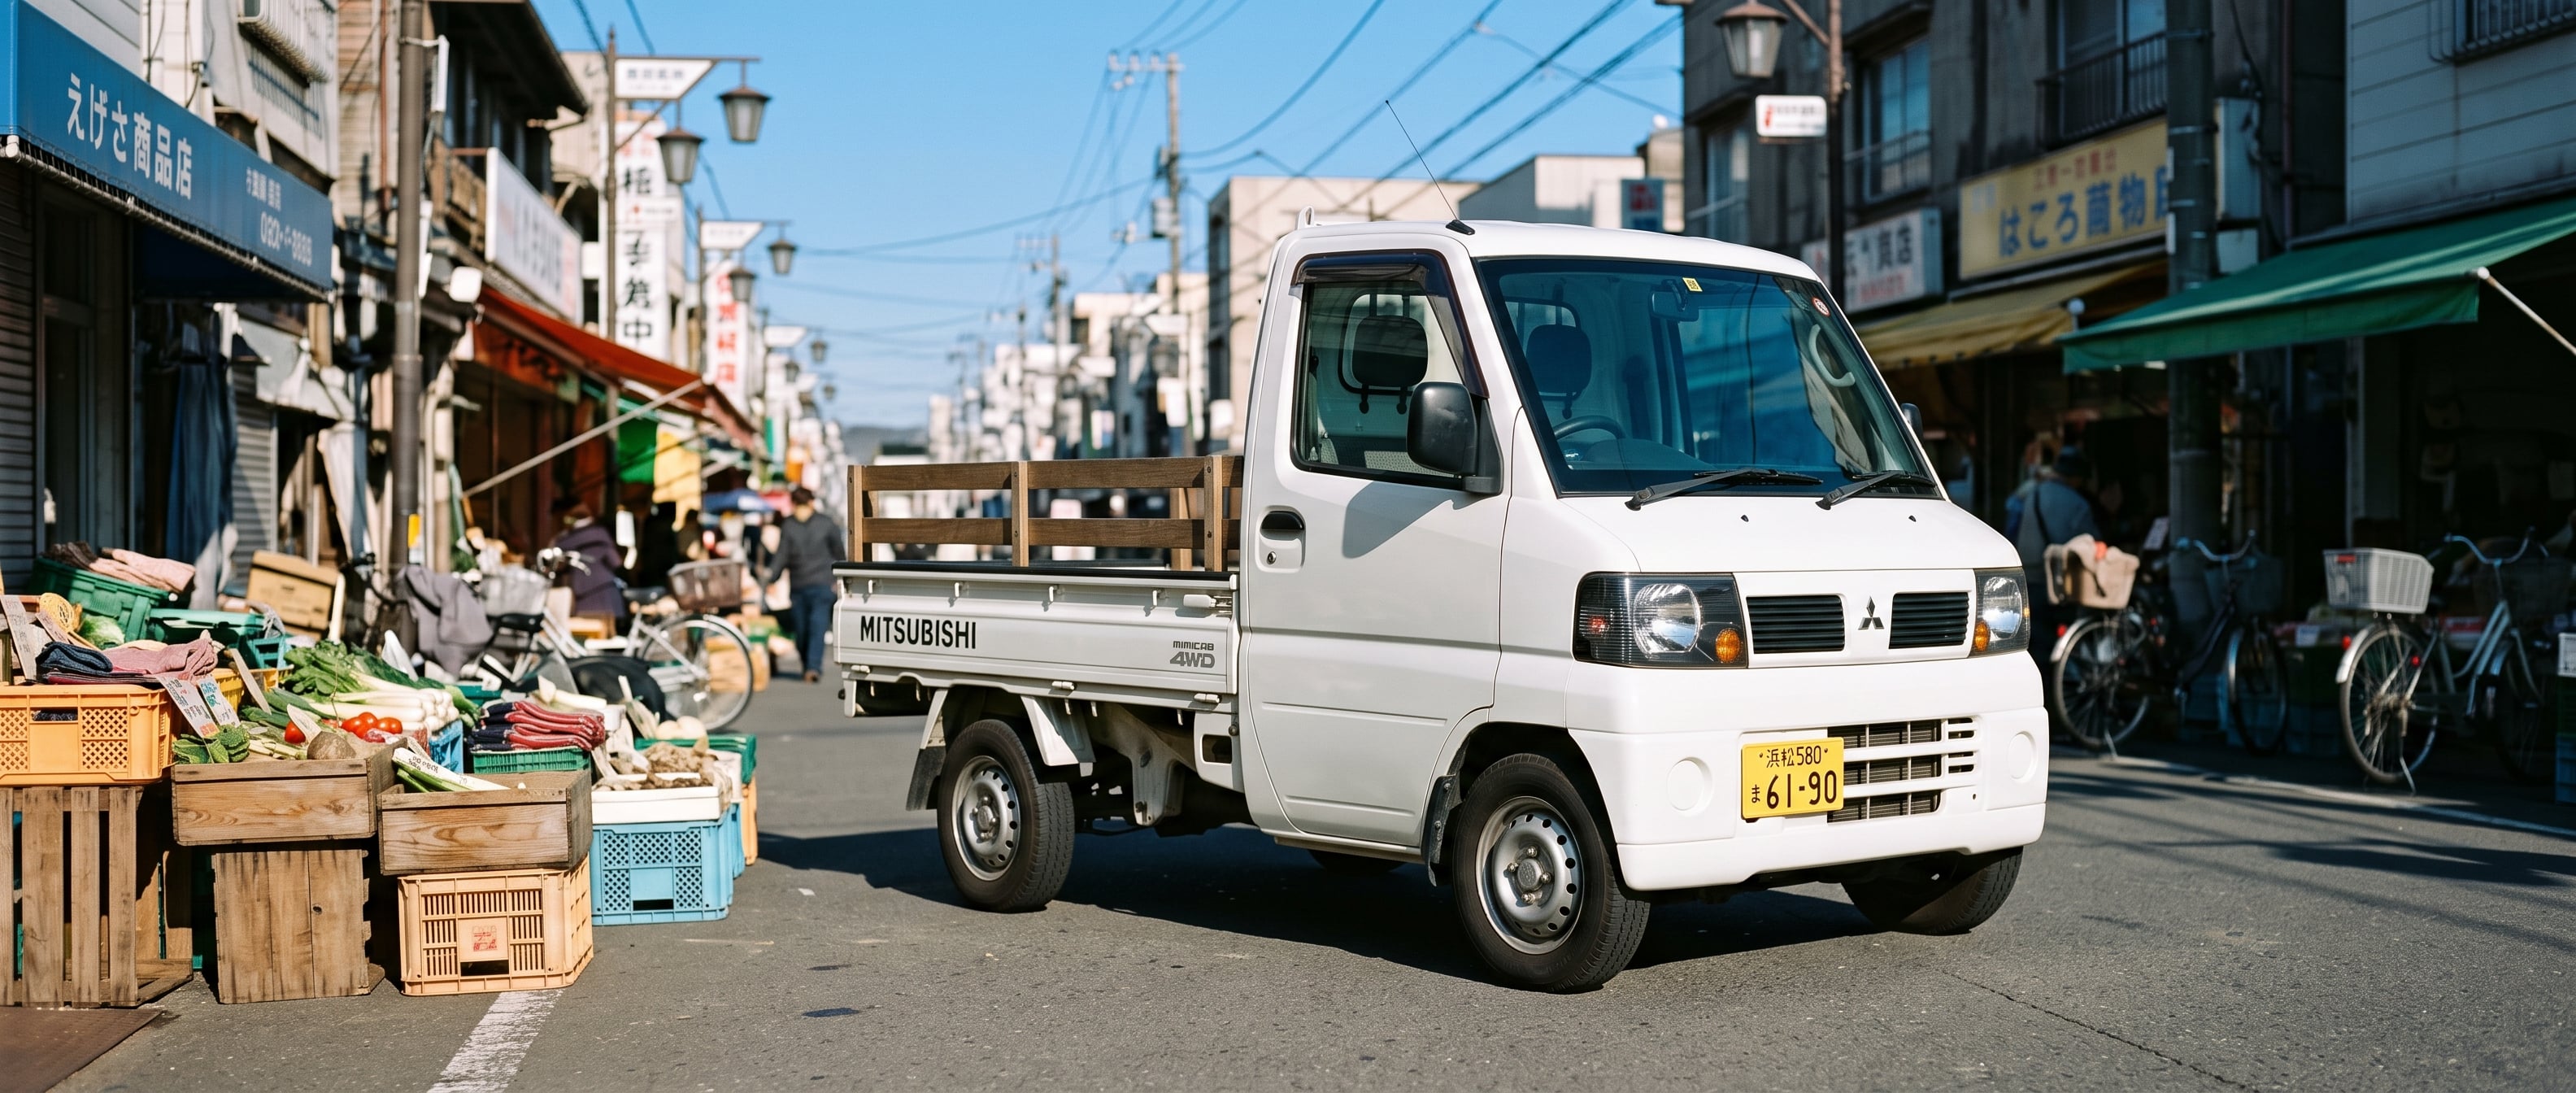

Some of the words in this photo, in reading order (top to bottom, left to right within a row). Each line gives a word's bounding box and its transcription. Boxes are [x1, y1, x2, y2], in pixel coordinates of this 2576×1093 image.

[67, 72, 193, 200] えげさ商品店
[859, 615, 977, 650] MITSUBISHI
[1169, 651, 1216, 668] 4WD
[1751, 783, 1761, 804] ま
[1766, 769, 1838, 810] 61-90
